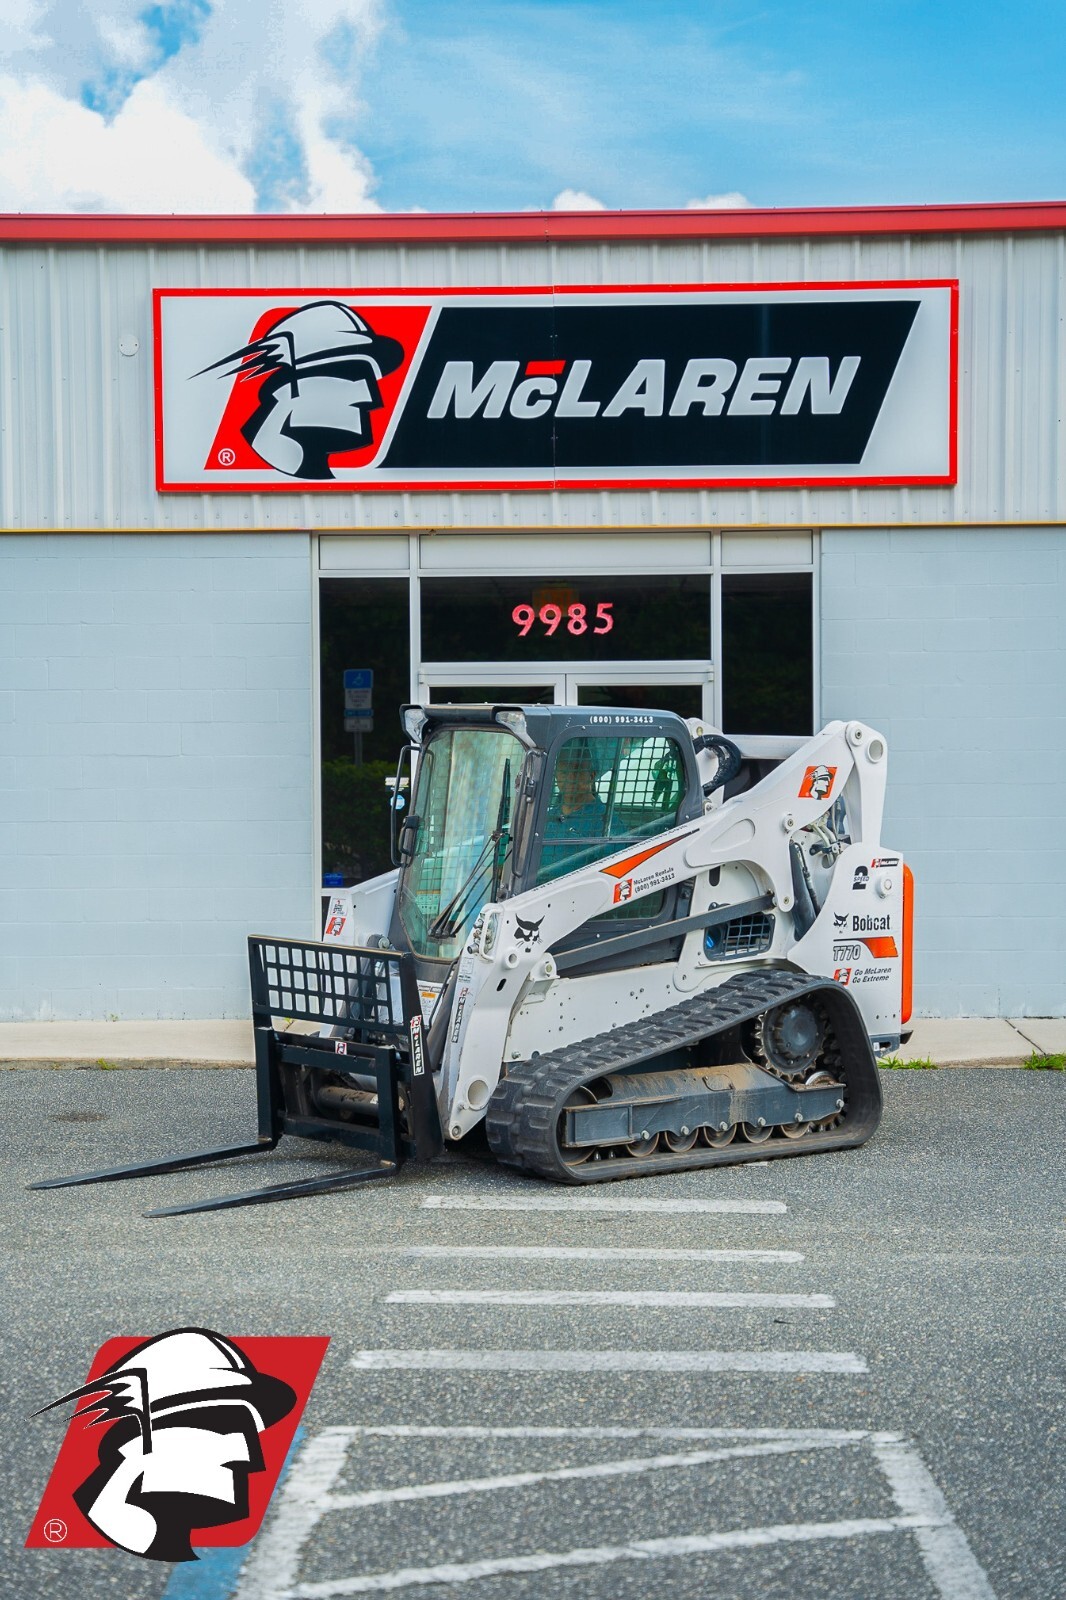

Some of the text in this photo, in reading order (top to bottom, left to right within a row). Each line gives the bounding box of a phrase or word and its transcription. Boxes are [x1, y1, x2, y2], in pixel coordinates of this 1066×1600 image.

[427, 356, 861, 419] McLAREN
[511, 602, 614, 636] 9985
[589, 715, 654, 725] (800) 991-3413
[852, 914, 891, 931] Bobcat
[833, 944, 861, 961] T770
[862, 975, 890, 983] Extreme
[864, 967, 892, 975] McLaren
